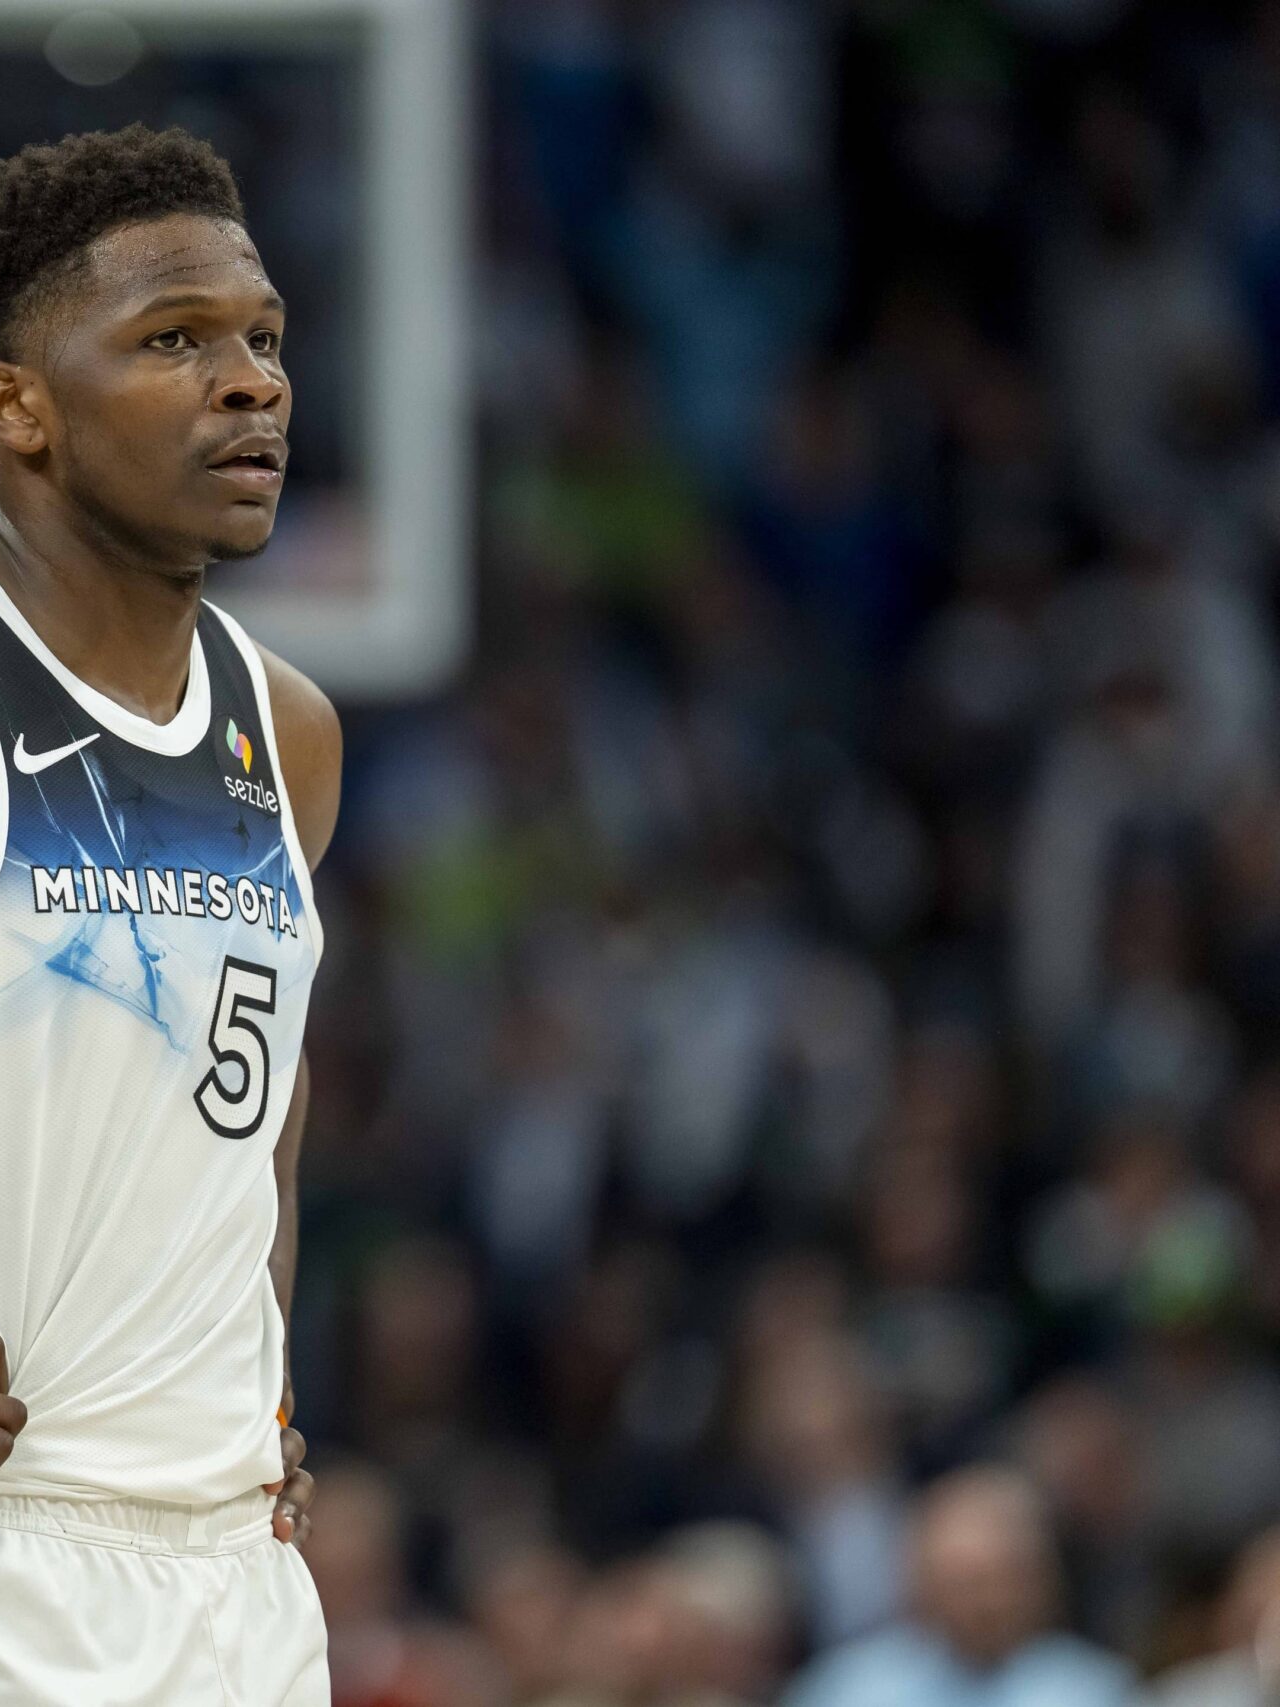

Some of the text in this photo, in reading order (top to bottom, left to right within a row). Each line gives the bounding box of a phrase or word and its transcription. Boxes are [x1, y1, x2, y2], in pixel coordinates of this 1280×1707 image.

[224, 774, 278, 812] sezzle
[31, 865, 298, 938] MINNESOTA
[194, 955, 277, 1139] 5
